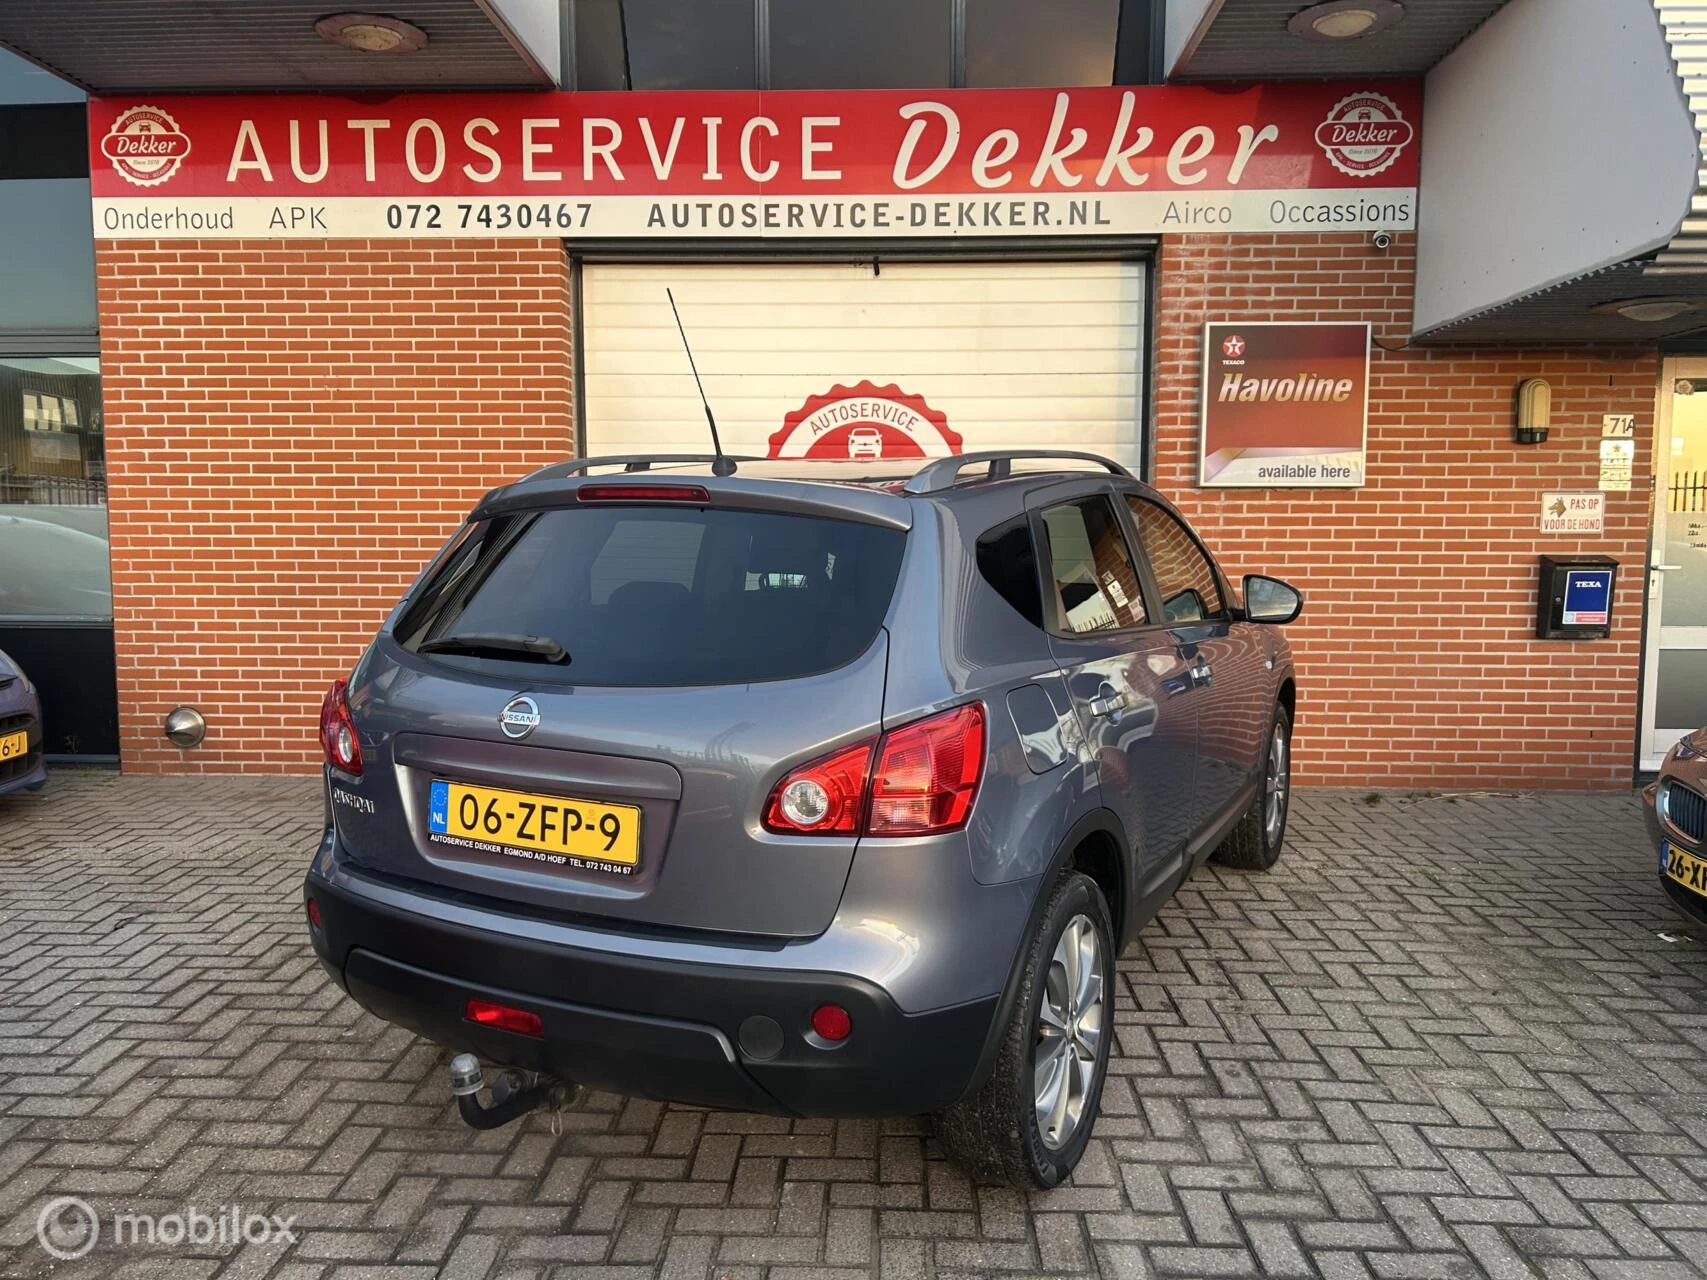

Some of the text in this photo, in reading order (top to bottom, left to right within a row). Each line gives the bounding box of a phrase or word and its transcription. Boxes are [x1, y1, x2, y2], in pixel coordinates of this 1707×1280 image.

[1343, 99, 1385, 113] AUTOSERVICE
[125, 112, 163, 126] AUTOSERVICE
[226, 90, 1279, 190] AUTOSERVICE Dekker
[1331, 122, 1398, 143] Dekker
[116, 134, 177, 154] Dekker
[103, 198, 1410, 231] Onderhoud APK 072 7430467 AUTOSERVICE-DEKKER.NL Airco Occassions
[1217, 373, 1353, 402] Havoline
[809, 402, 920, 436] AUTOSERVICE
[1258, 464, 1351, 478] available here
[1570, 498, 1600, 510] PAS OP
[1544, 519, 1601, 530] VOOR DE HOND
[501, 712, 535, 723] NISSAN
[433, 793, 622, 852] NL 06-ZFP-9
[430, 833, 474, 848] AUTOSERVICE
[474, 841, 502, 854] DEKKER
[503, 846, 534, 859] EGMOND
[547, 855, 568, 865] HOEF
[569, 858, 585, 868] TEL.
[586, 861, 599, 871] 072
[599, 863, 613, 873] 743
[613, 866, 622, 874] 04
[622, 867, 633, 876] 67
